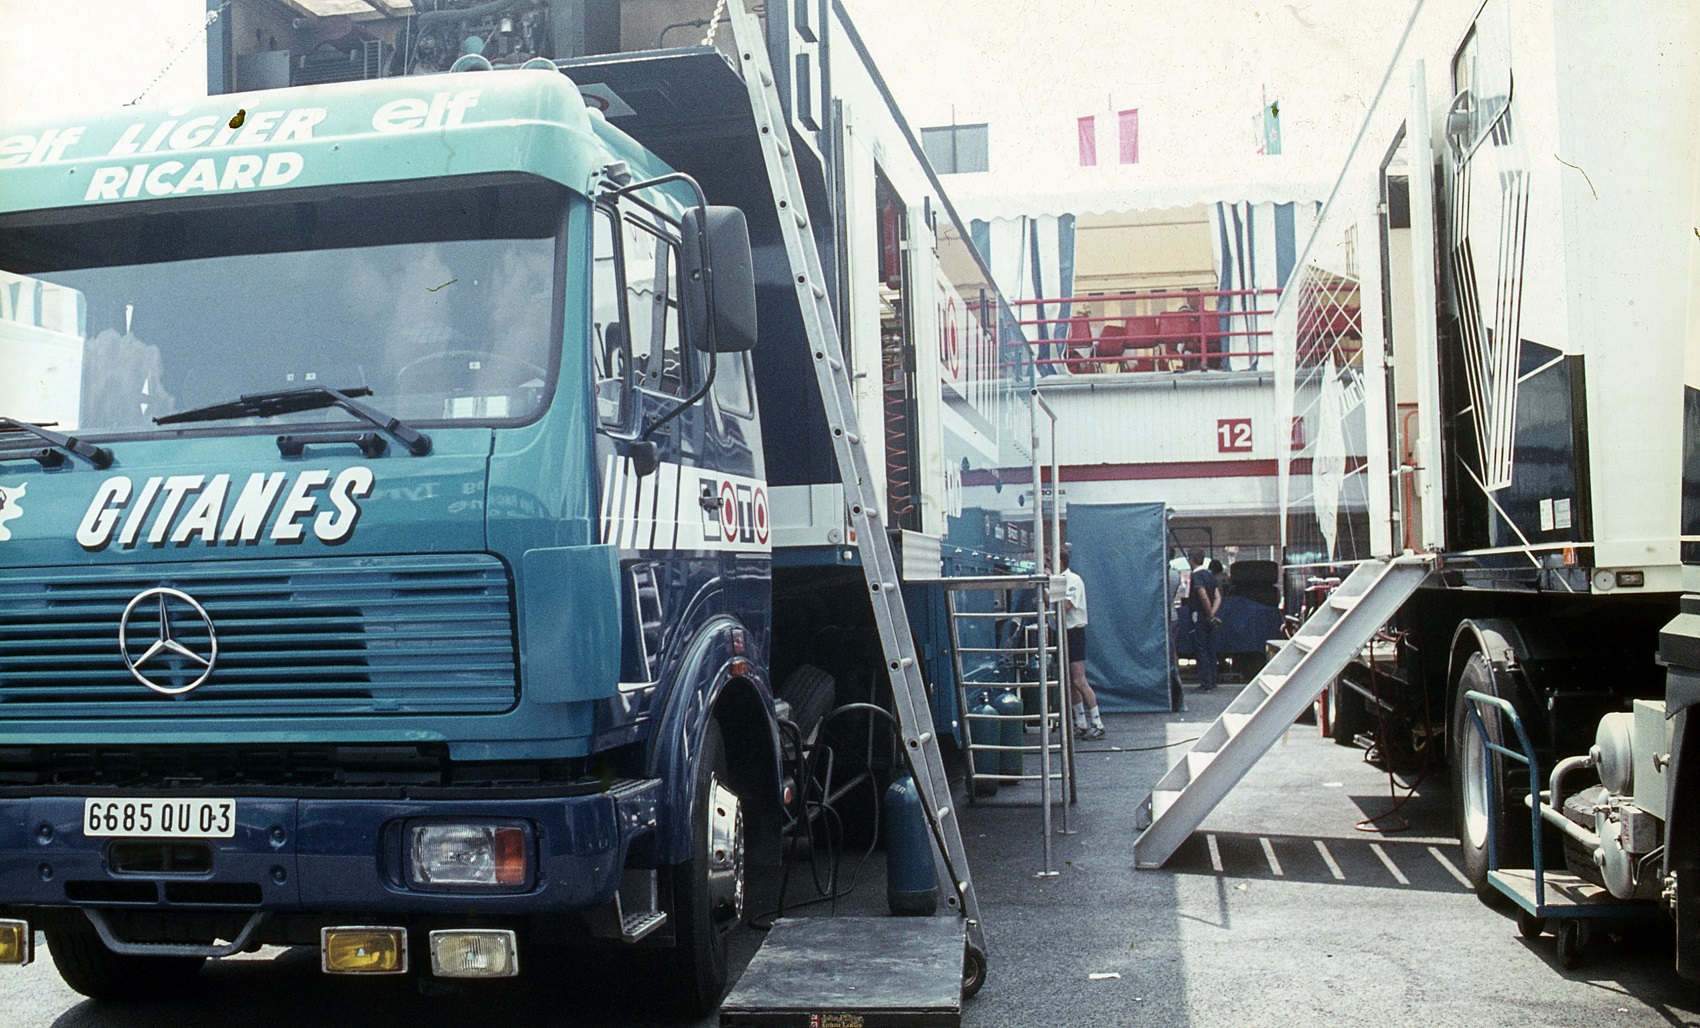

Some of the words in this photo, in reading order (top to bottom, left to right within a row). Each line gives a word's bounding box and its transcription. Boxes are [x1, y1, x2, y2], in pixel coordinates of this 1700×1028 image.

[107, 101, 328, 157] LIGIER
[372, 88, 481, 132] elf
[0, 126, 87, 167] elf
[84, 152, 304, 201] RICARD
[1218, 423, 1252, 448] 12
[76, 466, 375, 549] GITANES
[699, 478, 769, 545] LOTO
[89, 803, 153, 831] 6685
[161, 803, 191, 832] QU
[199, 804, 231, 832] 03
